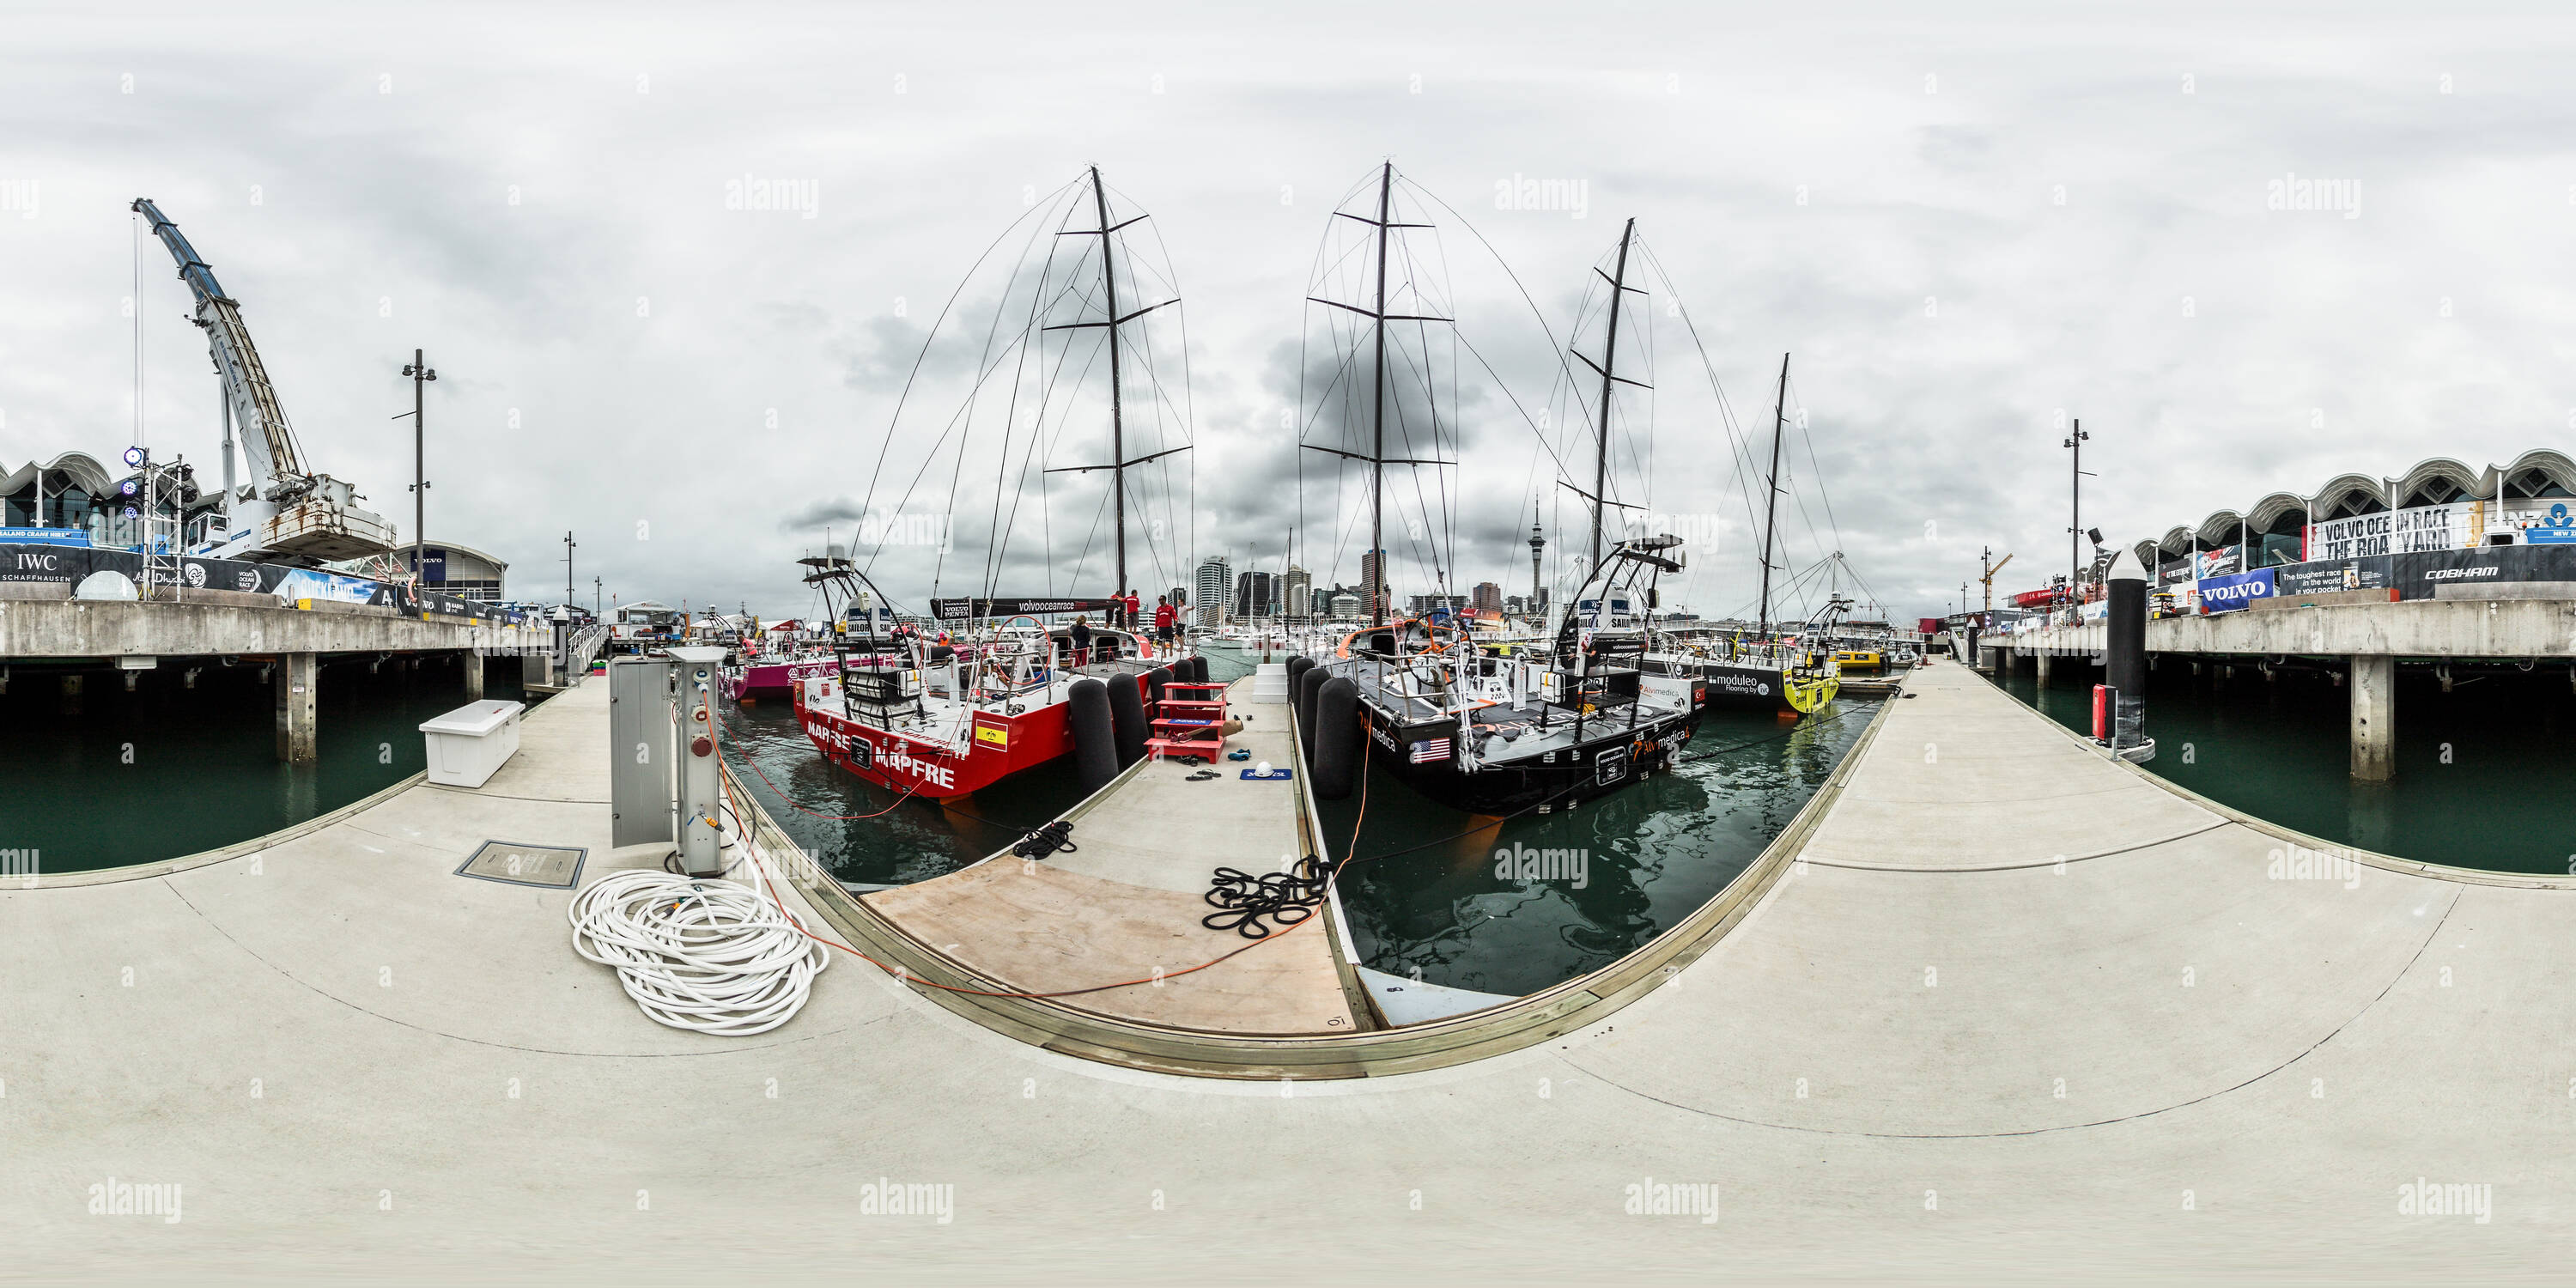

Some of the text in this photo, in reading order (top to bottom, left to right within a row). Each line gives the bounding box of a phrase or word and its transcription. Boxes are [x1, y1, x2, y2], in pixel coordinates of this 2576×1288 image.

[2325, 519, 2363, 542] VOLVO
[2413, 508, 2450, 530] RACE
[17, 553, 57, 571] IWC
[2296, 571, 2325, 580] toughest
[2425, 566, 2499, 580] COBHAM
[2202, 580, 2266, 602] VOLVO
[1717, 674, 1758, 686] moduleo
[1643, 686, 1680, 697] Alvimedica
[1726, 684, 1758, 694] Flooring by
[808, 721, 851, 750] MAPFRE
[876, 746, 955, 790] MAPFRE
